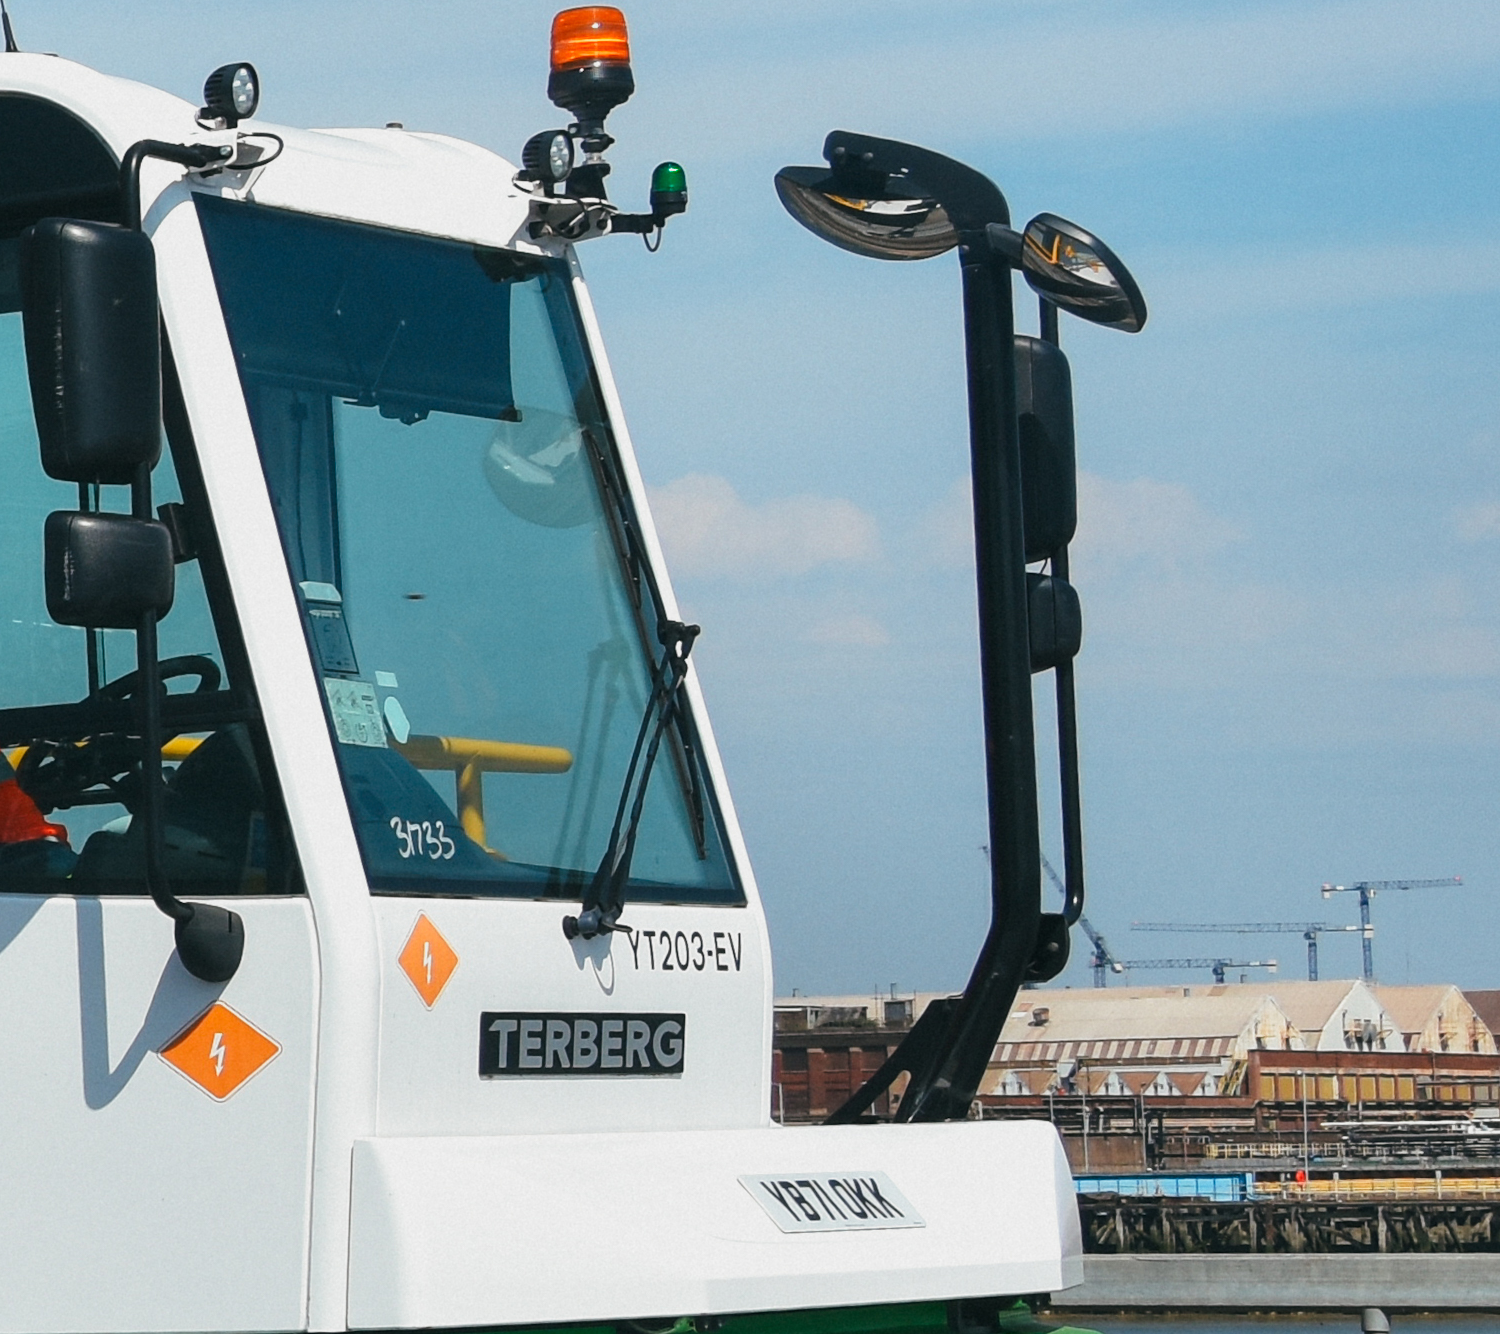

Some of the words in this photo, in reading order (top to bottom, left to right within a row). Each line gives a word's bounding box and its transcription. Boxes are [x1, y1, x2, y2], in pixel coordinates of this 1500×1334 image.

[389, 816, 456, 860] 31733
[627, 930, 742, 972] YT203-EV
[488, 1019, 683, 1068] TERBERG
